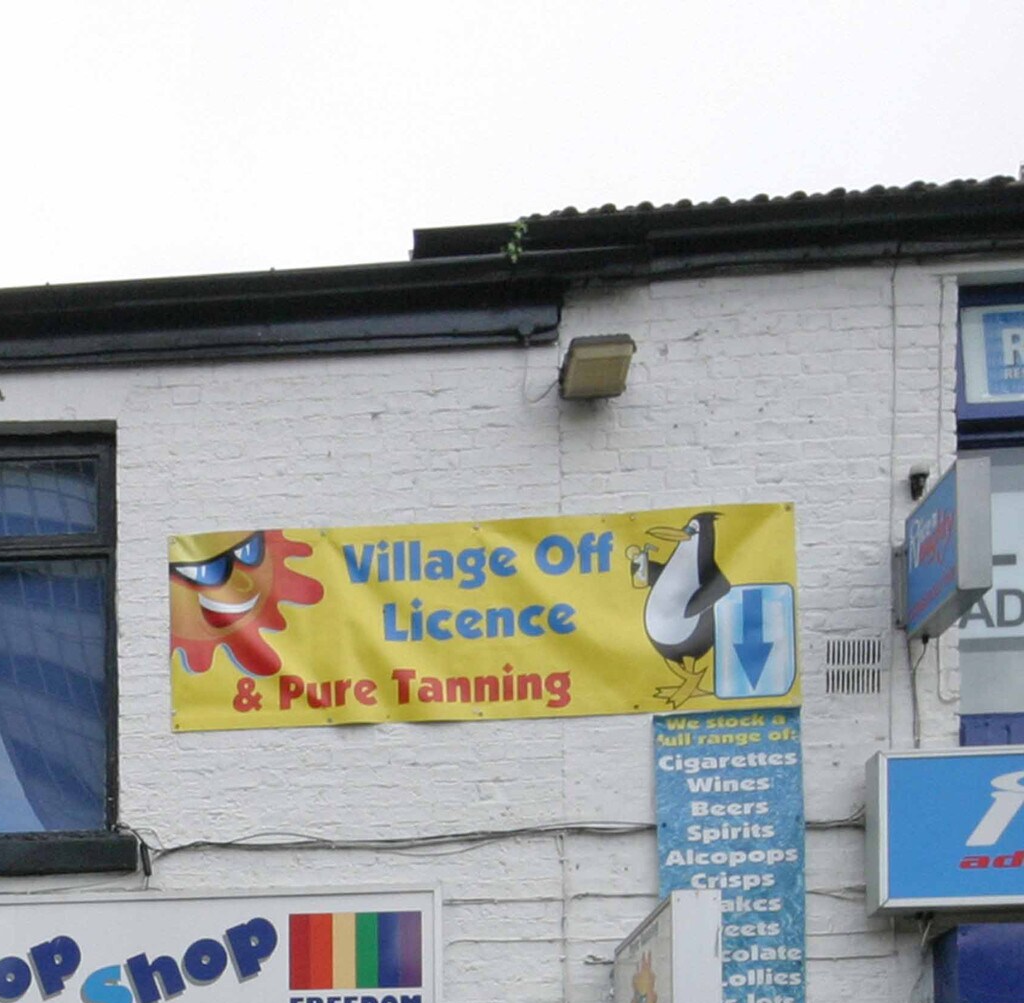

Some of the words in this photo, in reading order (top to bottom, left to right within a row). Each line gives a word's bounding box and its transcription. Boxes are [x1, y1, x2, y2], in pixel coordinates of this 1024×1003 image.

[1002, 328, 1024, 367] R
[343, 541, 516, 589] Village
[536, 531, 613, 573] Off
[383, 601, 576, 642] Licence
[232, 678, 262, 712] &
[279, 674, 377, 710] Pure
[392, 664, 572, 708] Tanning
[666, 718, 700, 731] We
[706, 713, 765, 729] stock
[772, 715, 786, 726] a
[698, 732, 761, 747] range
[658, 752, 798, 774] Cigarettes
[686, 776, 771, 793] Wines
[691, 801, 769, 816] Beers
[687, 822, 775, 844] Spirits
[665, 848, 798, 867] Alcopops
[691, 872, 775, 890] Crisps
[722, 896, 781, 912] akes
[724, 922, 780, 937] eets
[722, 944, 802, 962] colate
[722, 969, 802, 987] ollies
